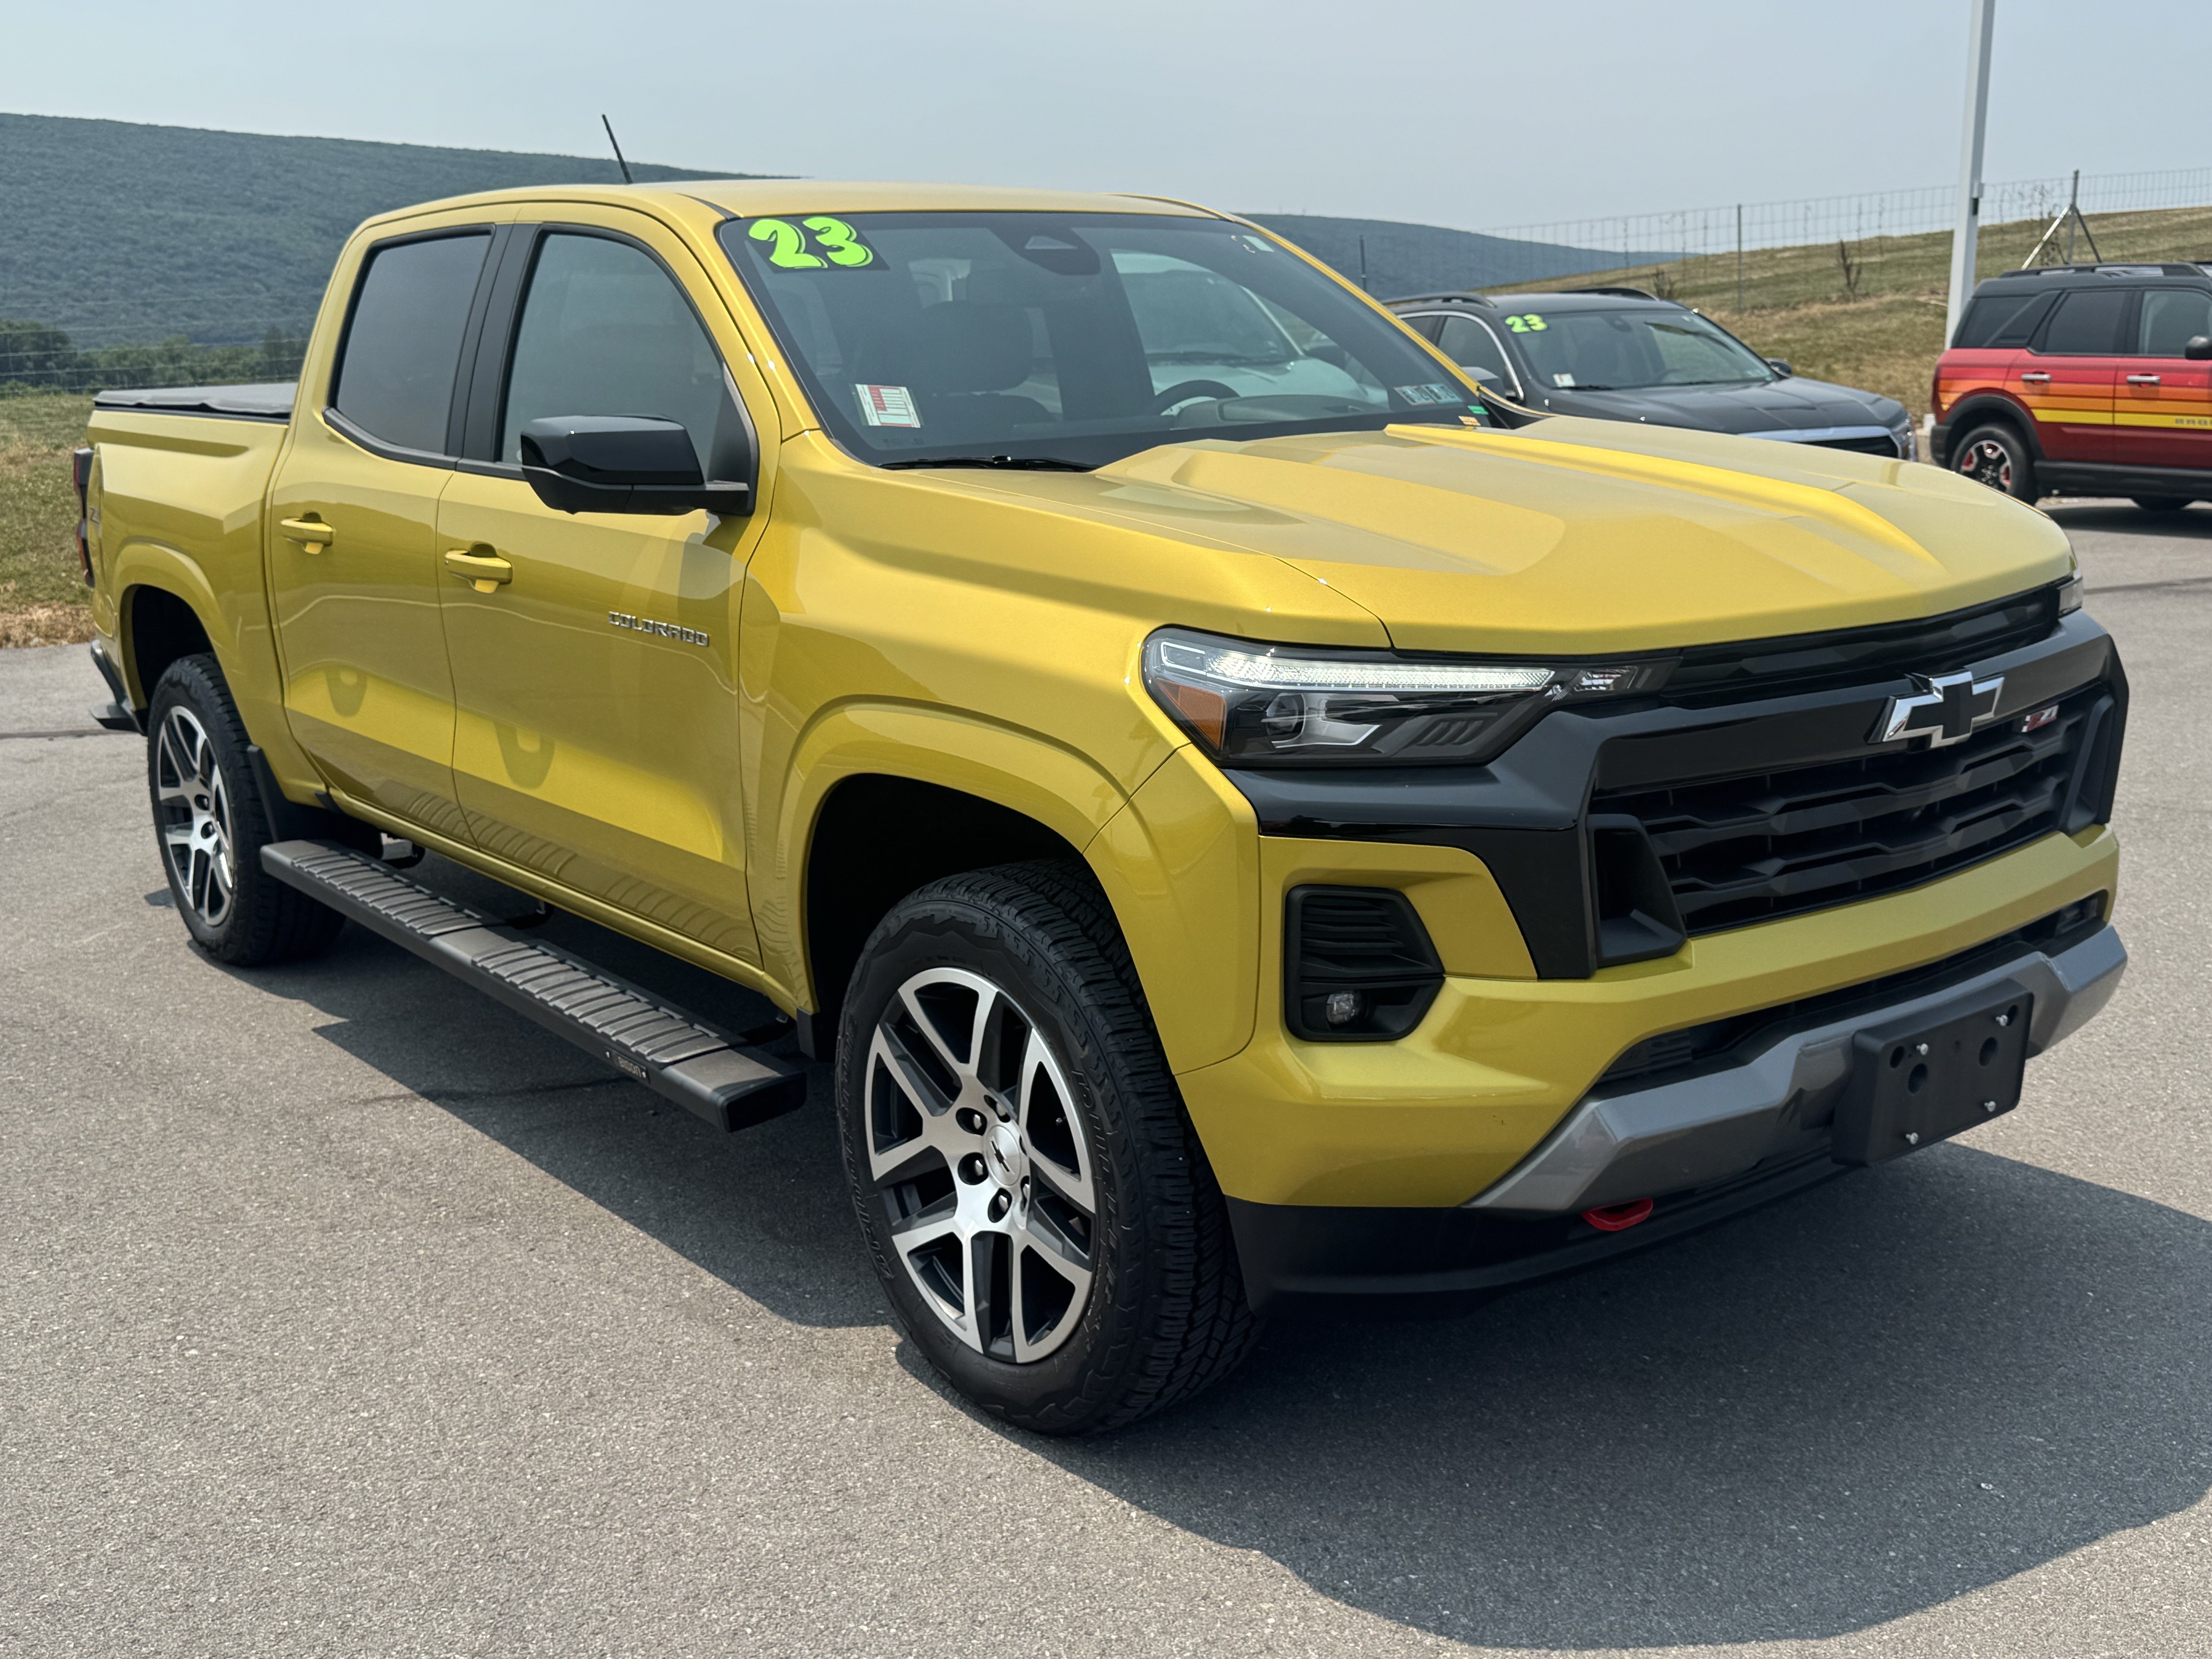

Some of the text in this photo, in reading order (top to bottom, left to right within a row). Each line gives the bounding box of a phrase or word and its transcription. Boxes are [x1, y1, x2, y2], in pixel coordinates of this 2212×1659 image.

[749, 216, 873, 268] 23
[1505, 314, 1547, 333] 23
[608, 611, 709, 647] COLORADO
